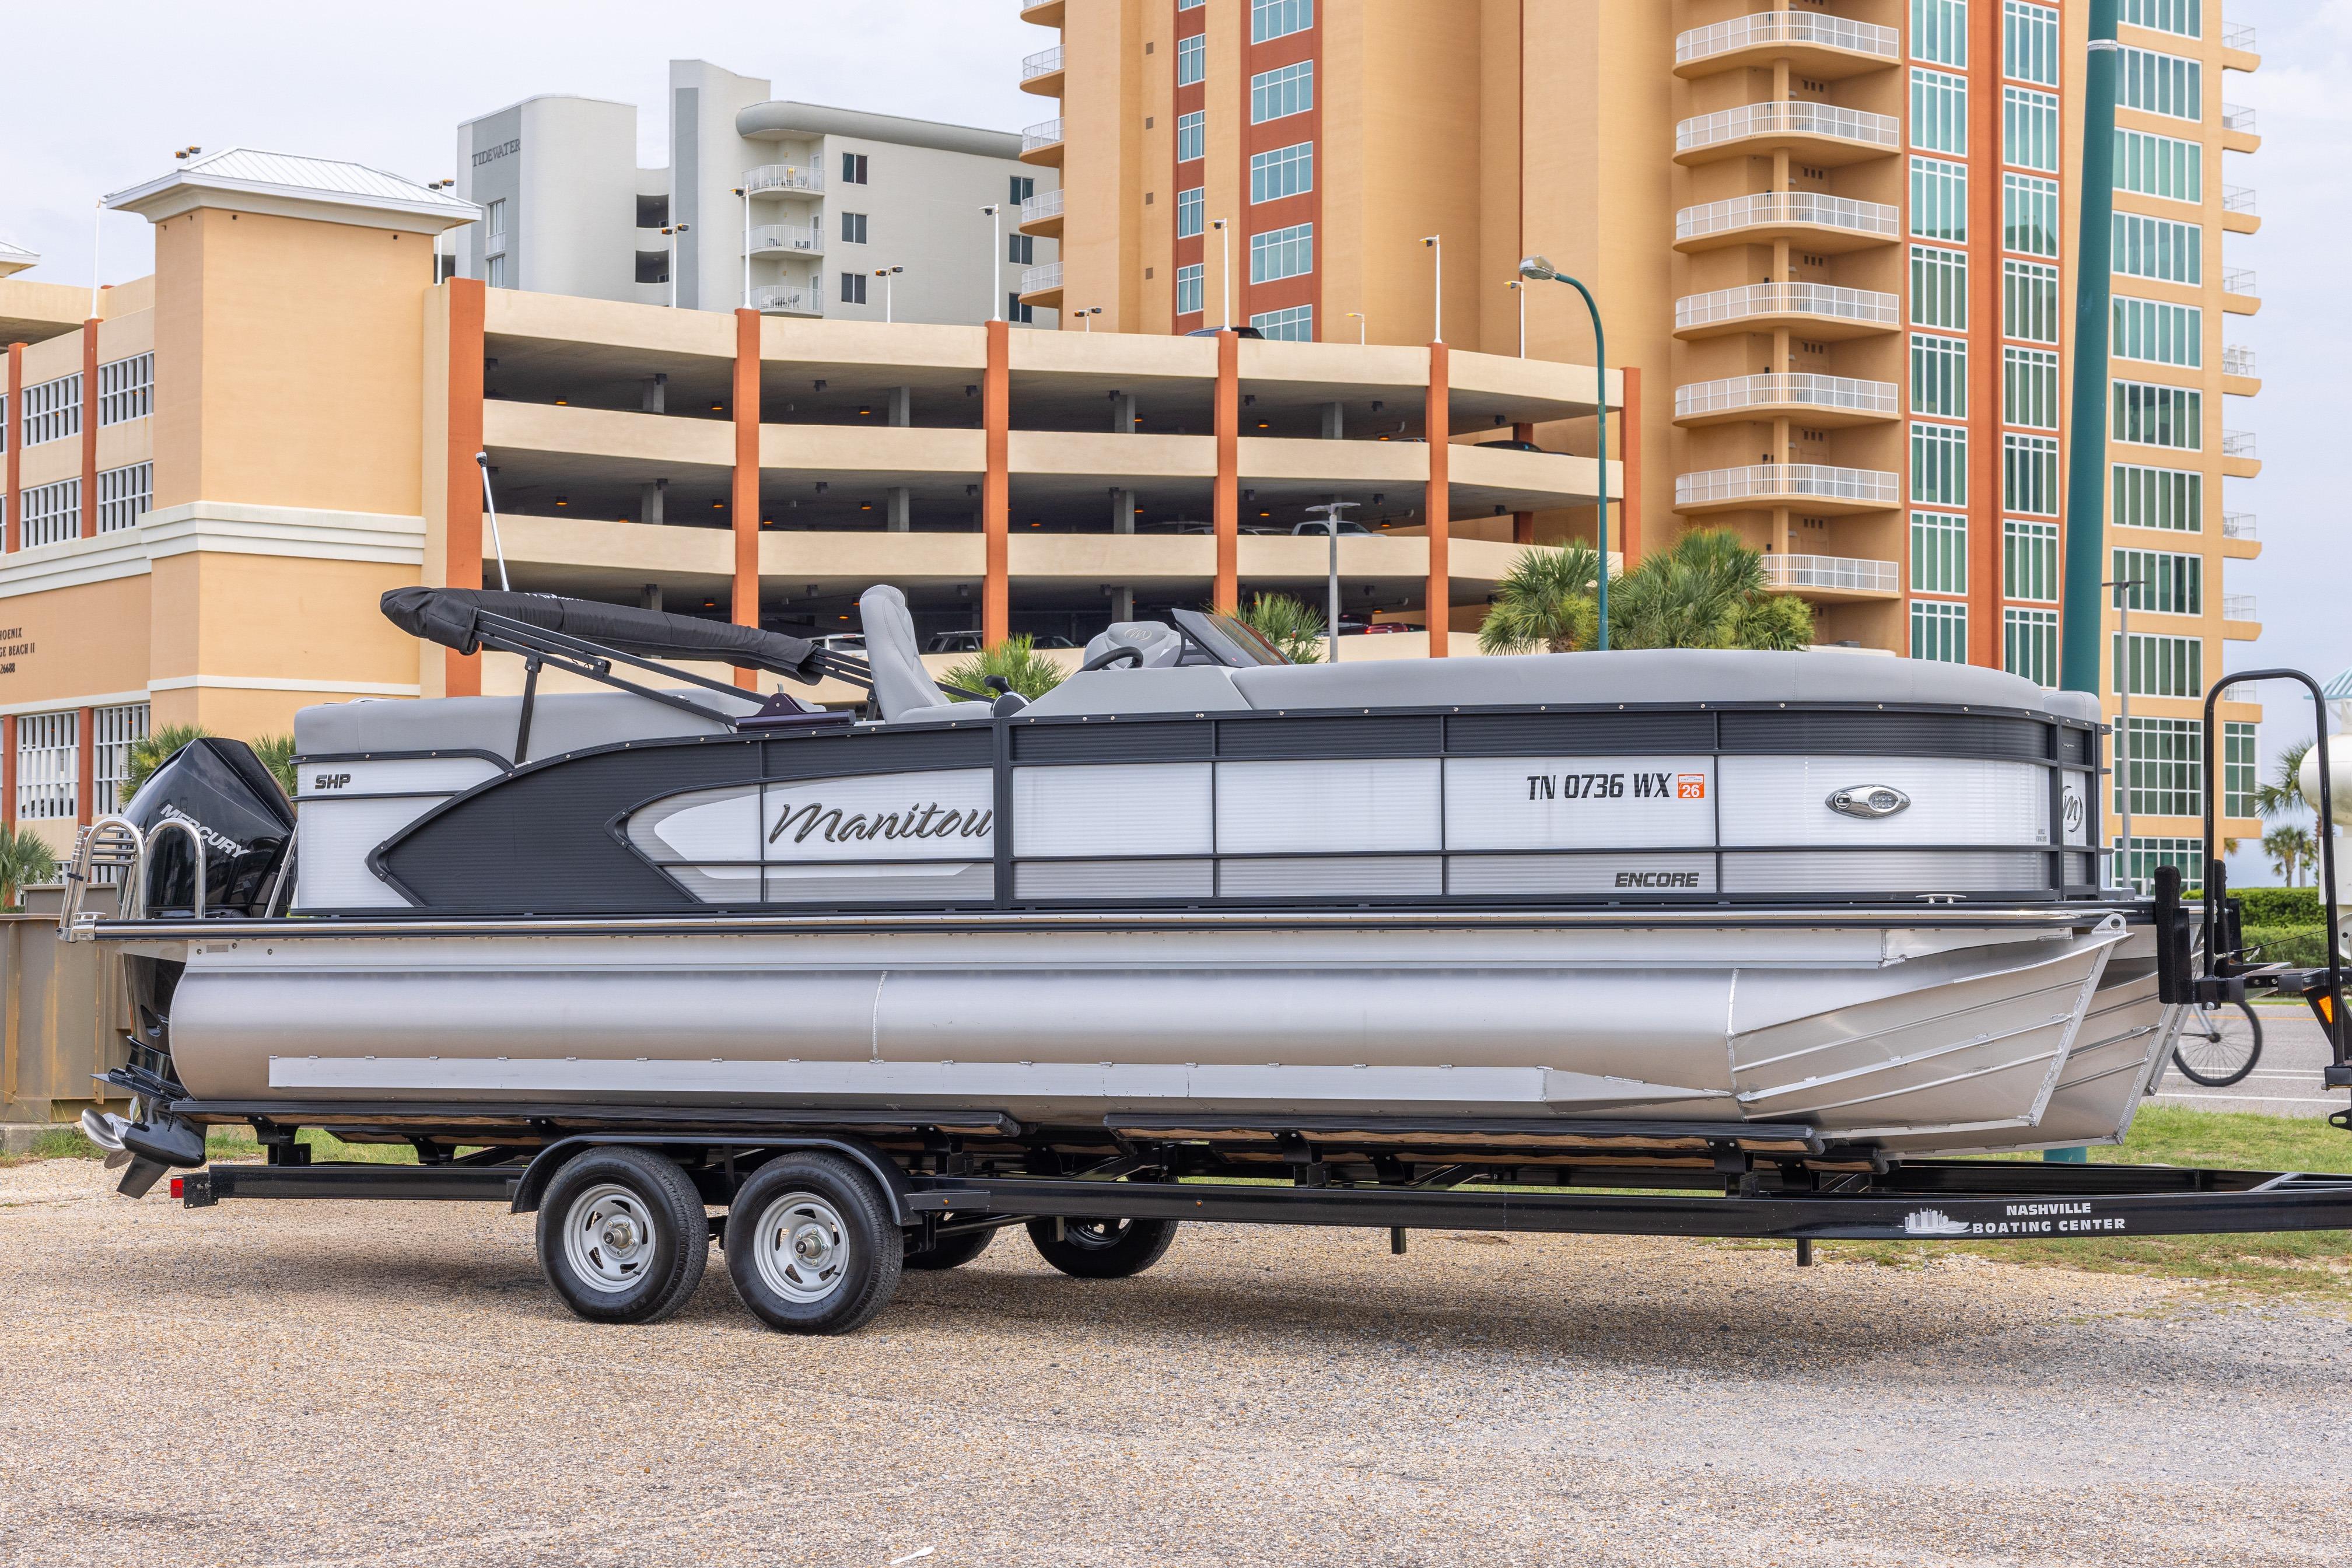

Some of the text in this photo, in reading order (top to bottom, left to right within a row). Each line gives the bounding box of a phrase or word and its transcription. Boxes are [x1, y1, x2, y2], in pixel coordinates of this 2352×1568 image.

[471, 138, 521, 167] TIDEWATER
[9, 643, 28, 656] BEACH
[30, 642, 35, 653] II
[315, 774, 351, 789] SHP
[1527, 773, 1672, 800] TN 0736 WX
[1682, 784, 1700, 797] 26
[769, 802, 993, 844] Manitou
[1615, 872, 1699, 887] ENCORE
[2006, 1202, 2091, 1216] NASHVILLE
[1973, 1218, 2125, 1234] BOATING CENTER
